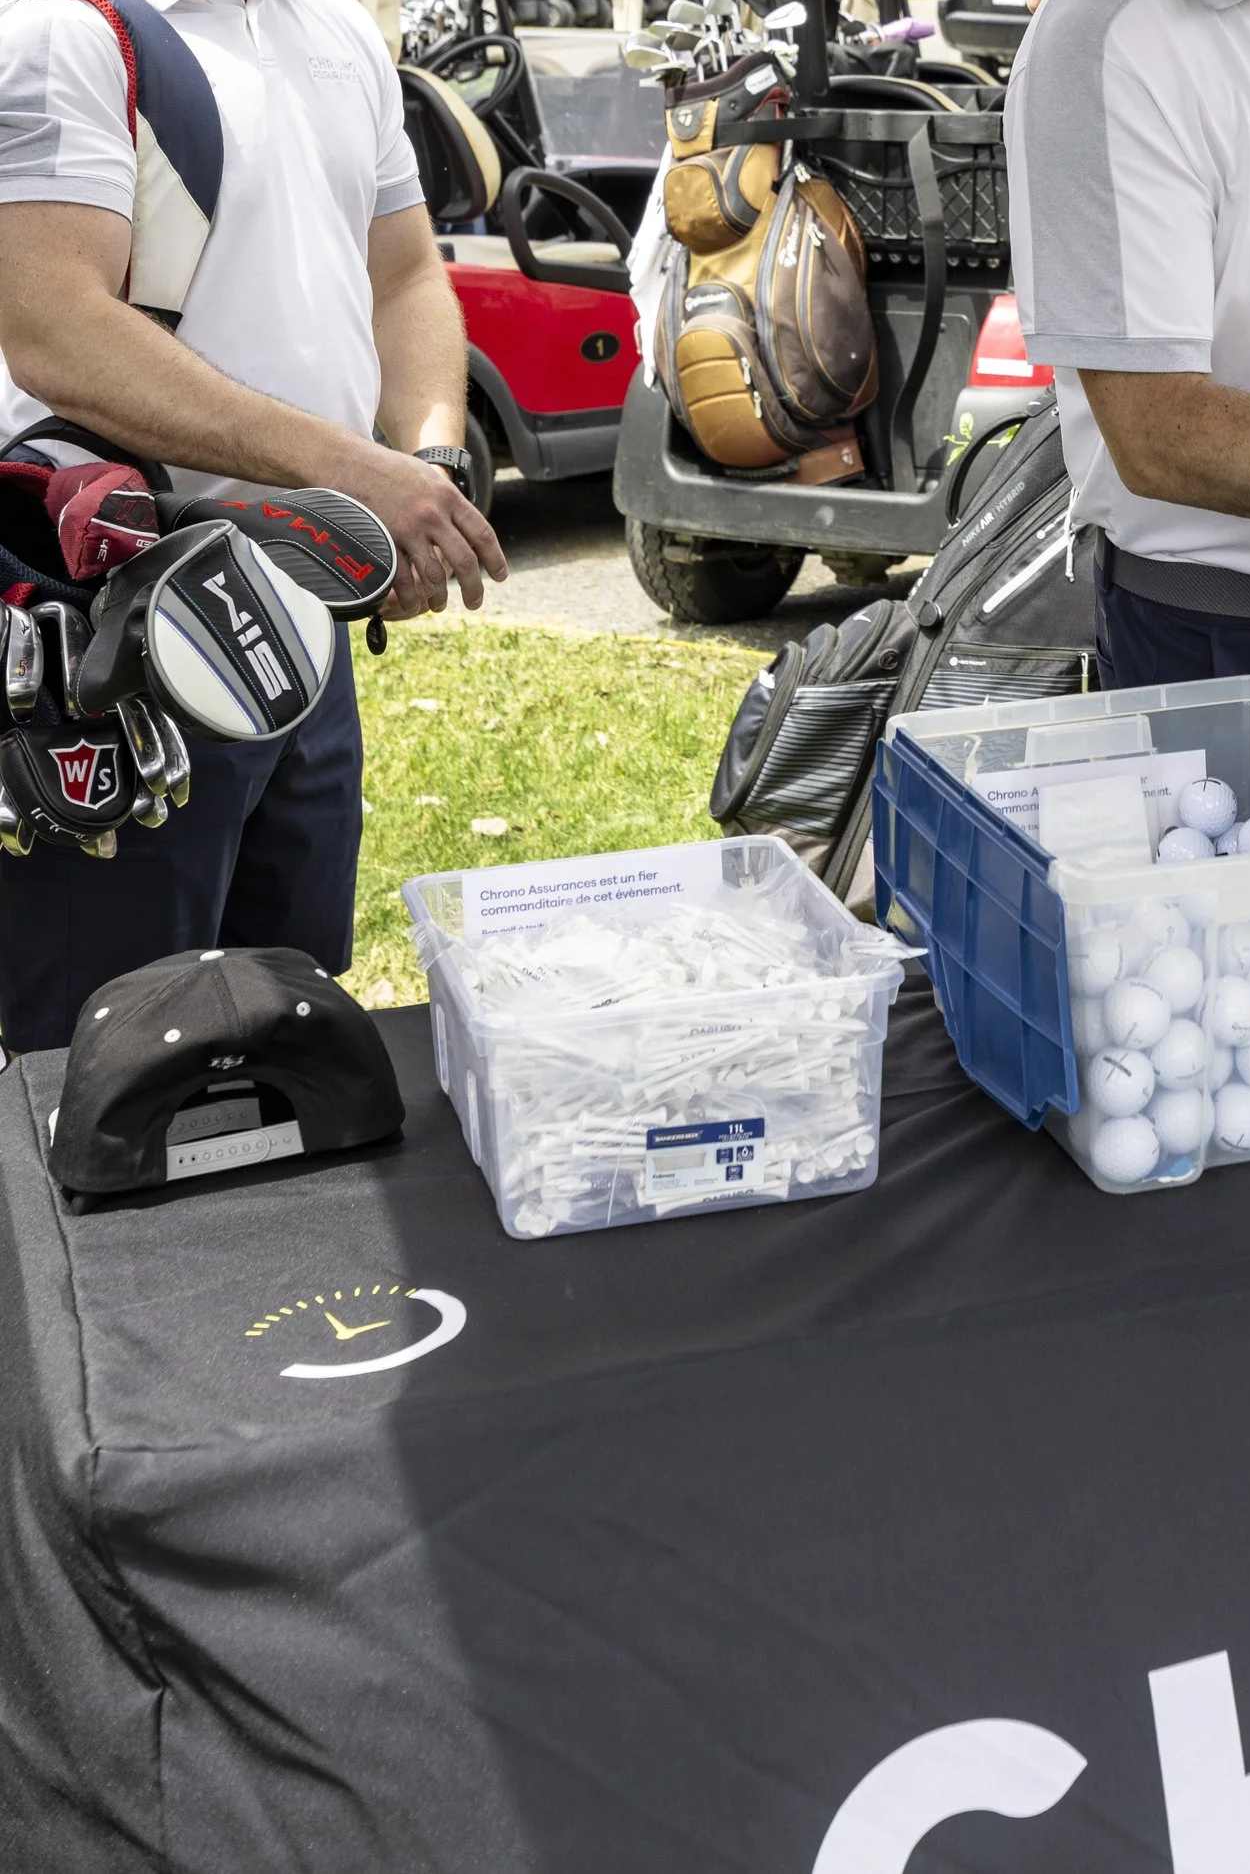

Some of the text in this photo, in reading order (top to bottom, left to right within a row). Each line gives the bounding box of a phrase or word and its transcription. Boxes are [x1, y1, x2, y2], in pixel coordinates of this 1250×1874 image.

[961, 481, 1026, 547] NIKE AIR HYBRID
[202, 571, 292, 701] SIM
[987, 790, 1028, 802] Chrono
[480, 870, 658, 902] Chrono Assurances est un fier
[480, 881, 685, 917] commanditaire de cet évènement.
